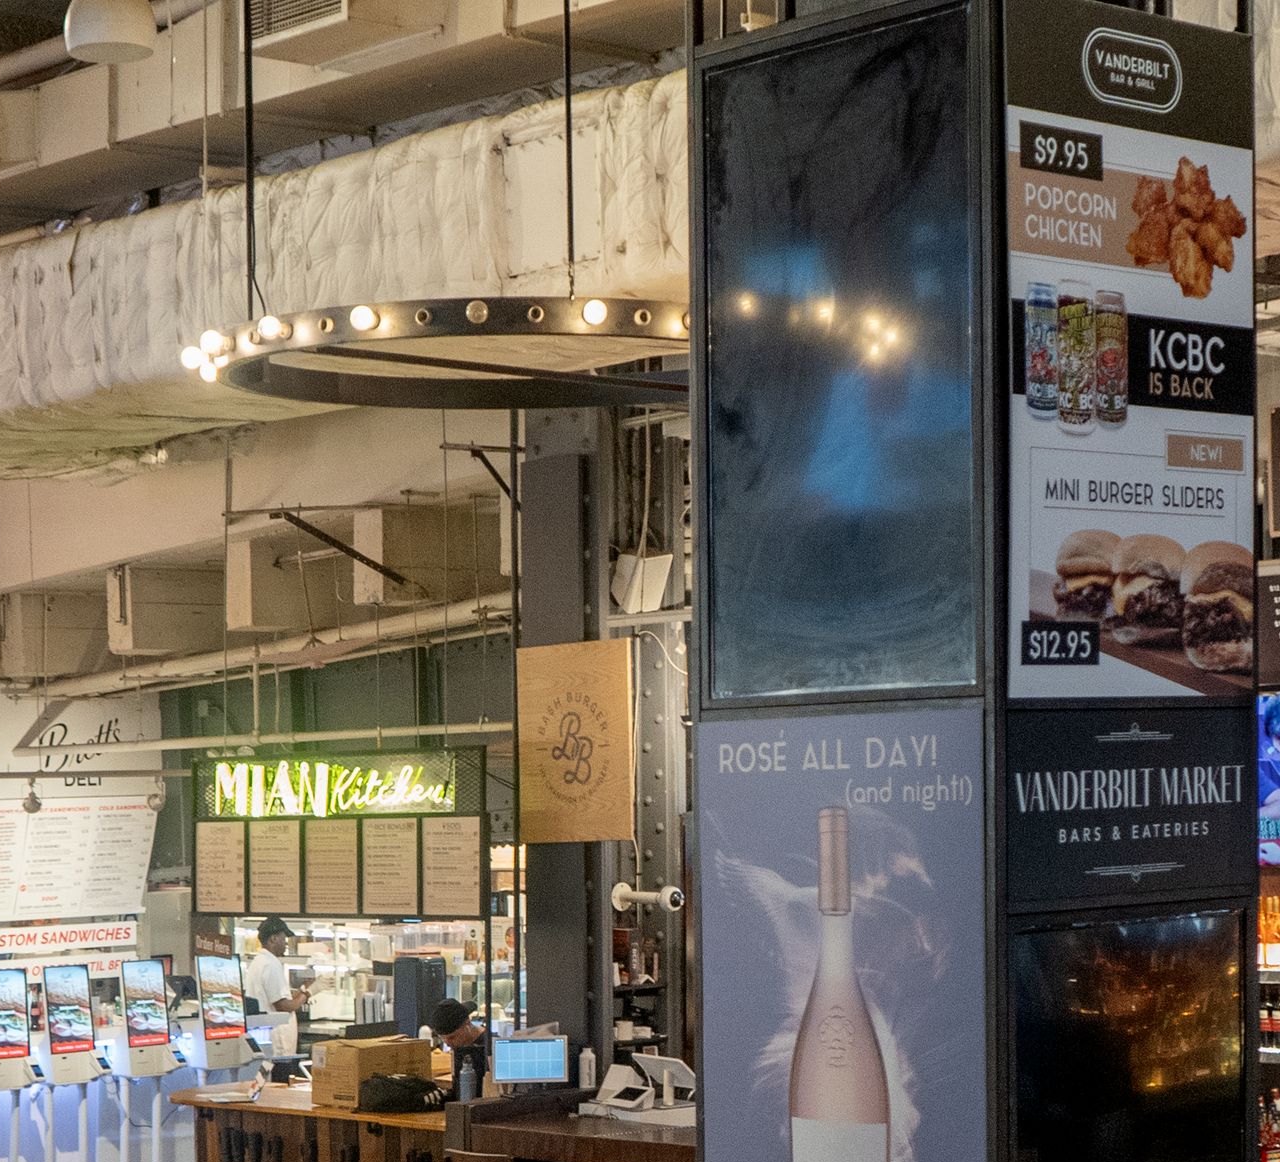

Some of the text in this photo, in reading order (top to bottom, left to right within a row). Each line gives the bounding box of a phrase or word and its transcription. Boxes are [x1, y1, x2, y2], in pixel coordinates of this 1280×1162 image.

[1096, 49, 1170, 79] VANDERBILT
[1110, 73, 1156, 91] BAR & GRILL
[1034, 134, 1088, 170] $9.95
[1025, 182, 1117, 220] POPCORN
[1025, 214, 1102, 248] CHICKEN
[1148, 327, 1226, 374] KCBC
[1149, 372, 1215, 400] IS BACK
[1191, 444, 1223, 462] NEW!
[1046, 478, 1225, 510] MINI BURGER SLIDERS
[1030, 629, 1091, 659] $12.95
[566, 692, 608, 732] BURGER
[719, 730, 938, 773] ROSÉ ALL DAY!
[64, 775, 103, 787] DELI
[215, 760, 330, 818] MIAN
[845, 775, 972, 811] (and night!)
[1016, 764, 1245, 813] VANDERBILT MARKET
[1059, 821, 1210, 843] BARS & EATERIES
[40, 927, 132, 945] SANDWICHES
